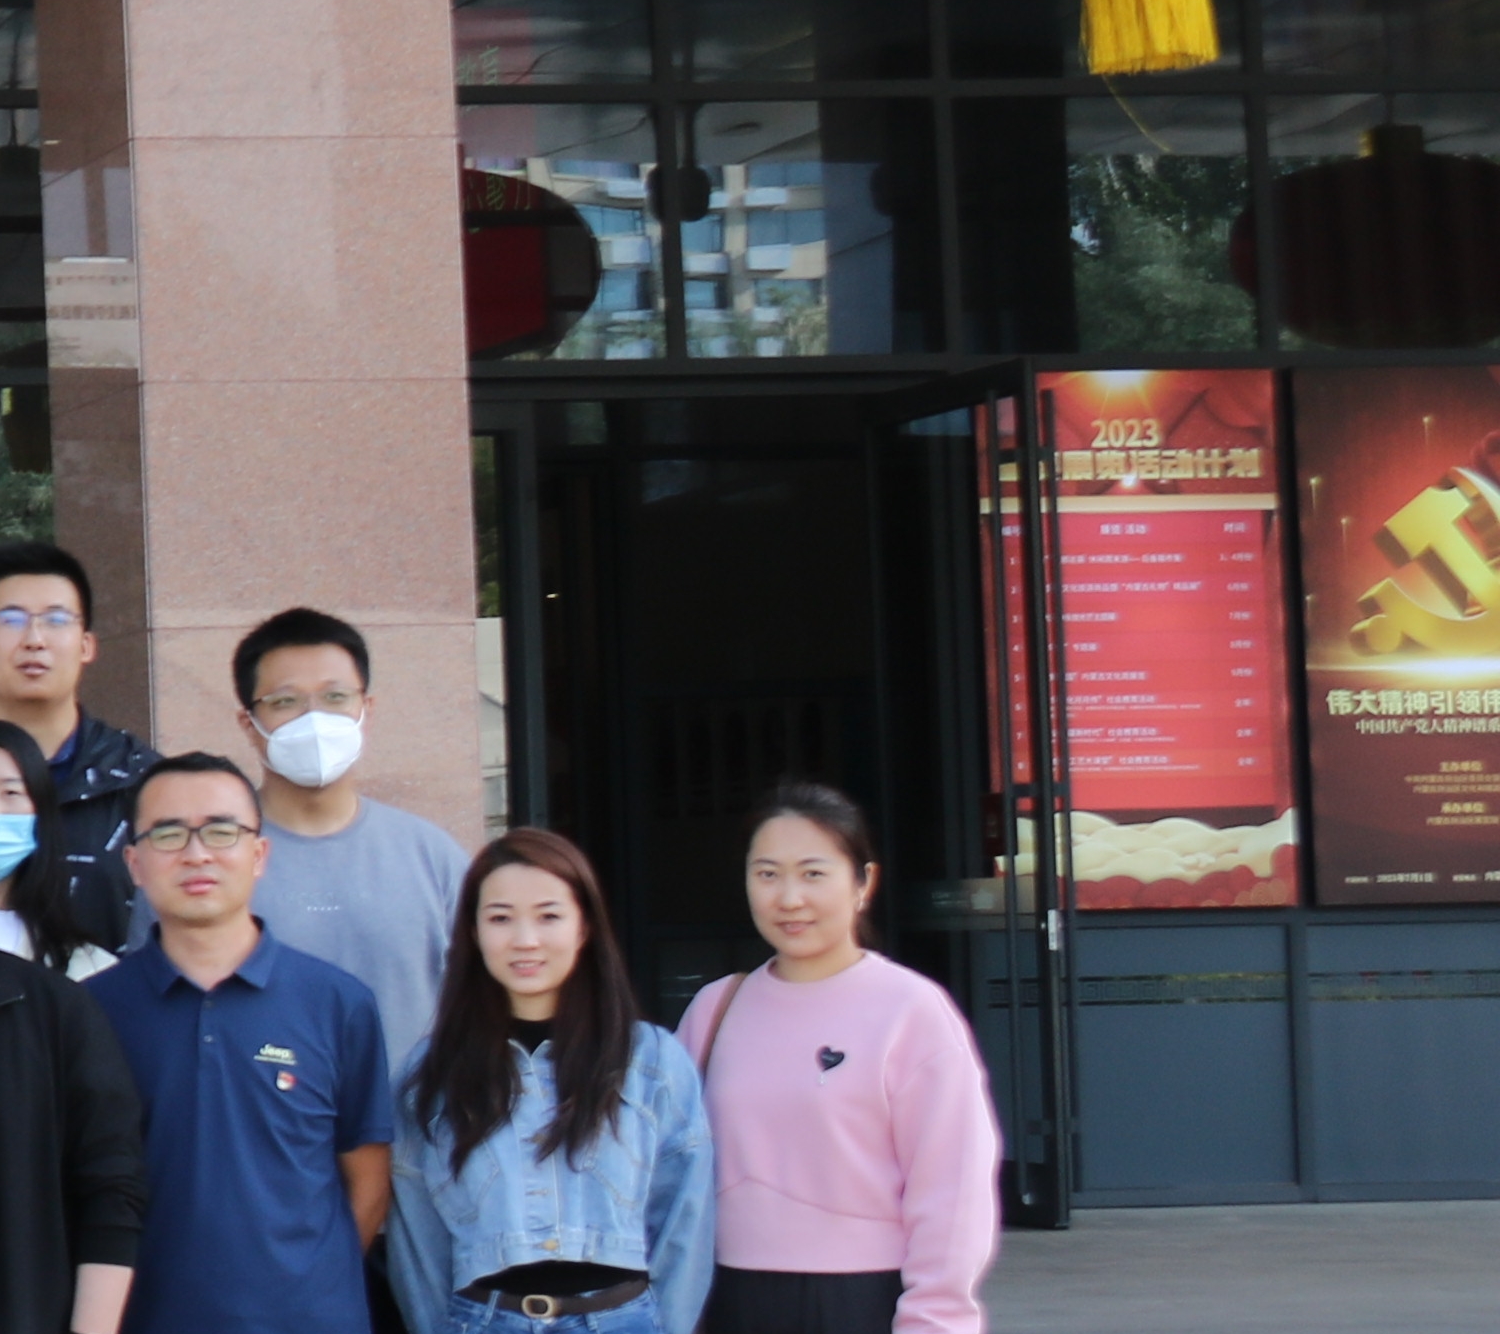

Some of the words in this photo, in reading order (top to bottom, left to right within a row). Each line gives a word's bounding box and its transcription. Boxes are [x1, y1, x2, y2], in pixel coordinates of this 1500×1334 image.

[1091, 419, 1162, 447] 2023
[999, 448, 1262, 481] 展览活动计划
